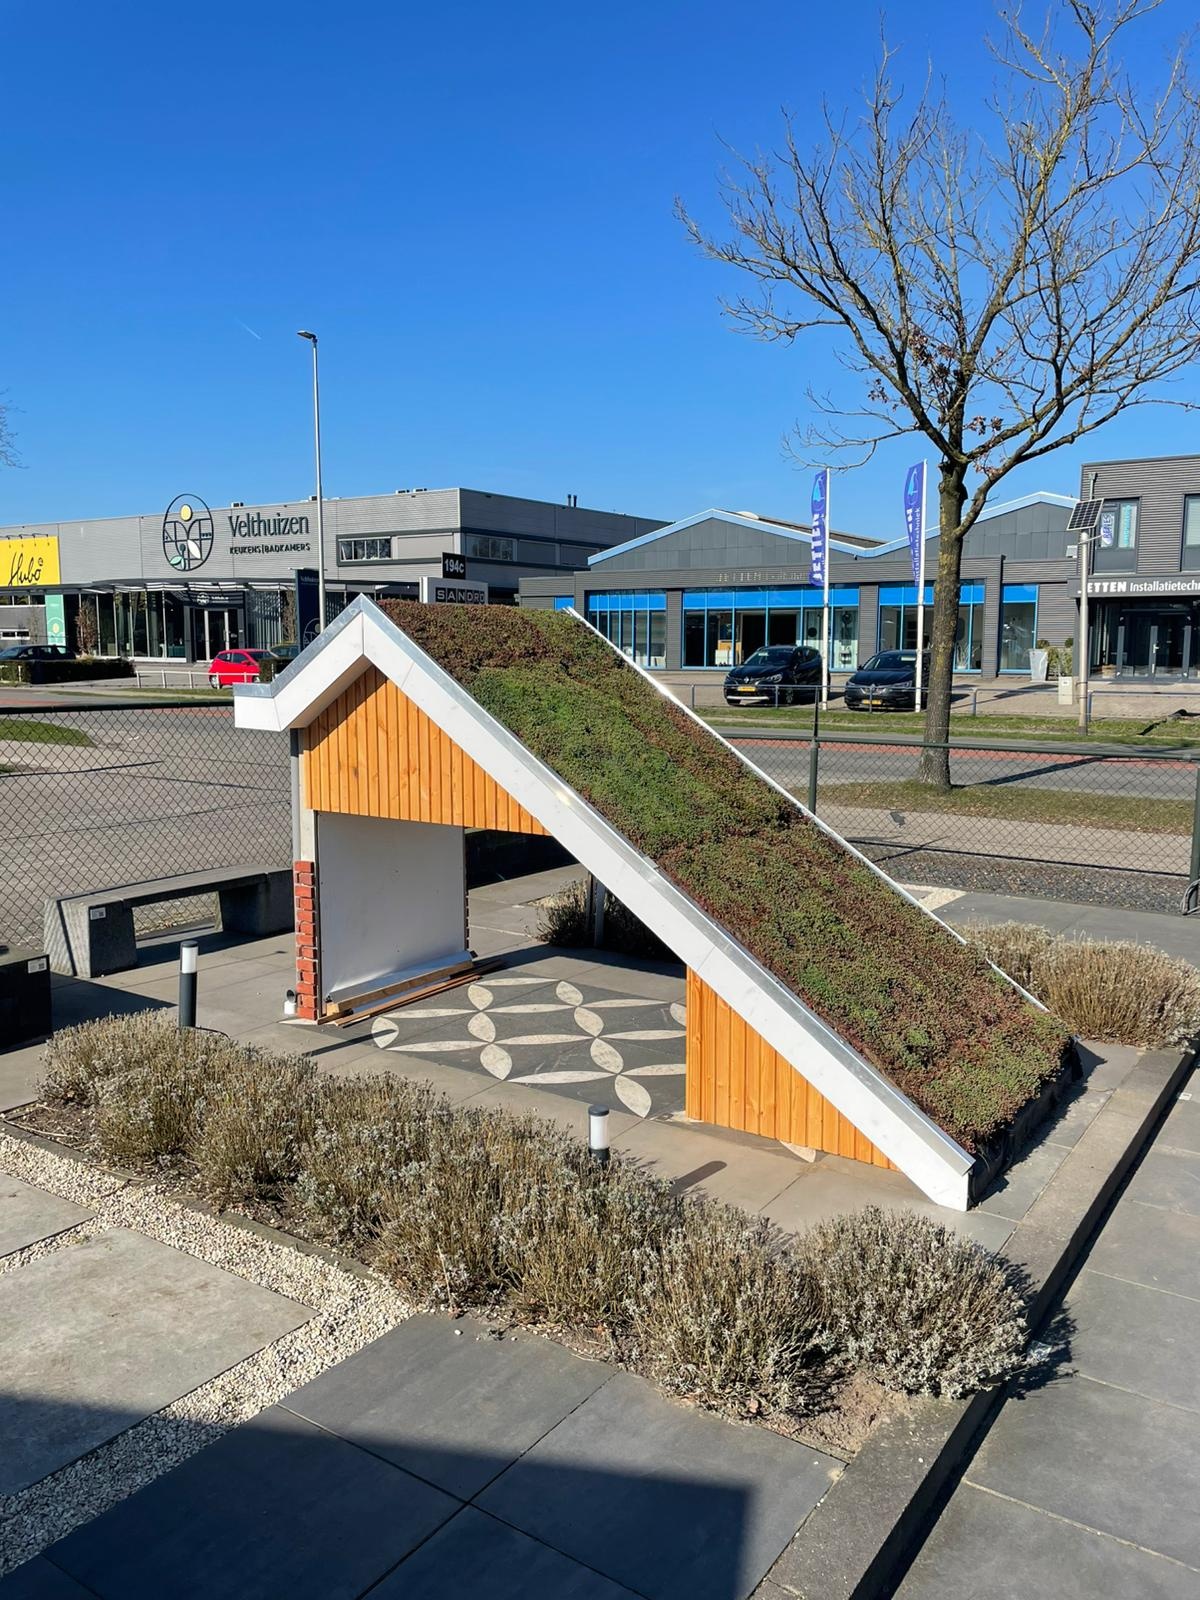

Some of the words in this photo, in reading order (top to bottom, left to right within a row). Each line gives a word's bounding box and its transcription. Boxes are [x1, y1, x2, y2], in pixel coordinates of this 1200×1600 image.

[228, 512, 310, 538] Velthuizen
[8, 552, 43, 587] Hubo
[444, 559, 464, 573] 194c
[1130, 579, 1200, 592] Installatietech
